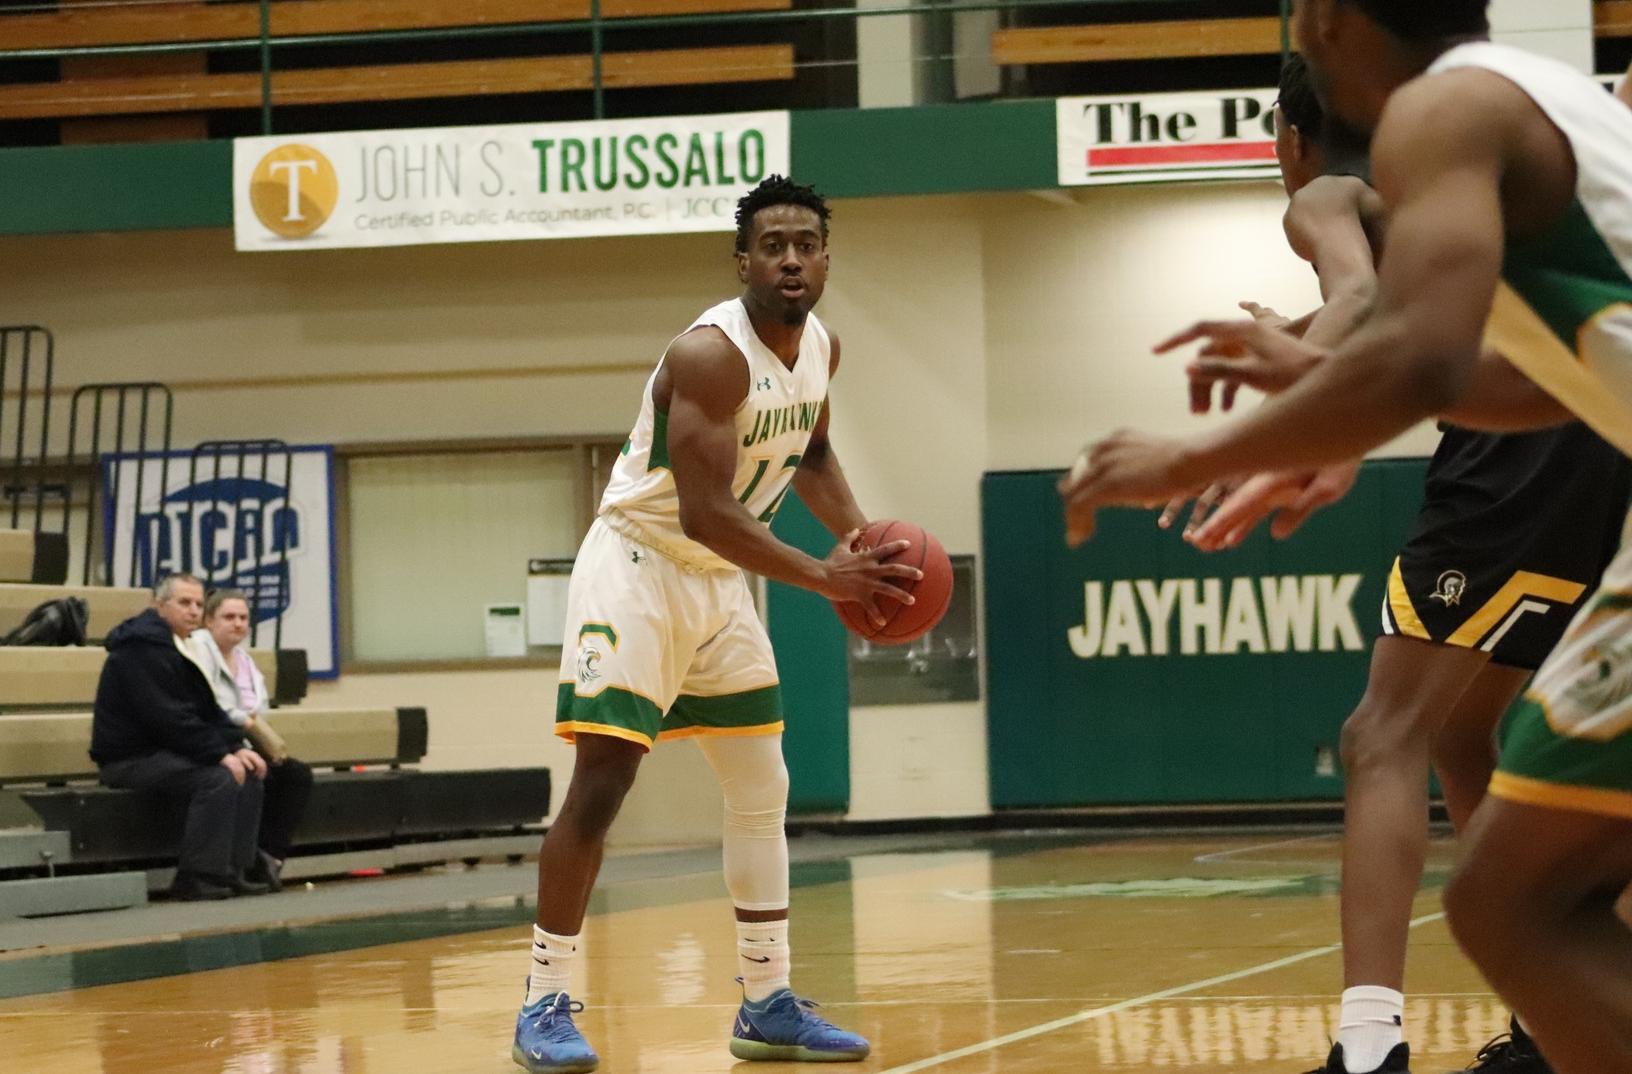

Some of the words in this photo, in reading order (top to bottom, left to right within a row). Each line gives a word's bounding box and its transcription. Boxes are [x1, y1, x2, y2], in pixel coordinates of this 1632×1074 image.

[1082, 101, 1198, 144] The
[269, 159, 318, 223] T
[355, 143, 461, 203] JOHN
[479, 140, 516, 197] S.
[531, 128, 766, 193] TRUSSALO
[354, 209, 434, 231] Certified
[439, 207, 500, 227] Public
[1066, 572, 1365, 659] JAYHAWK
